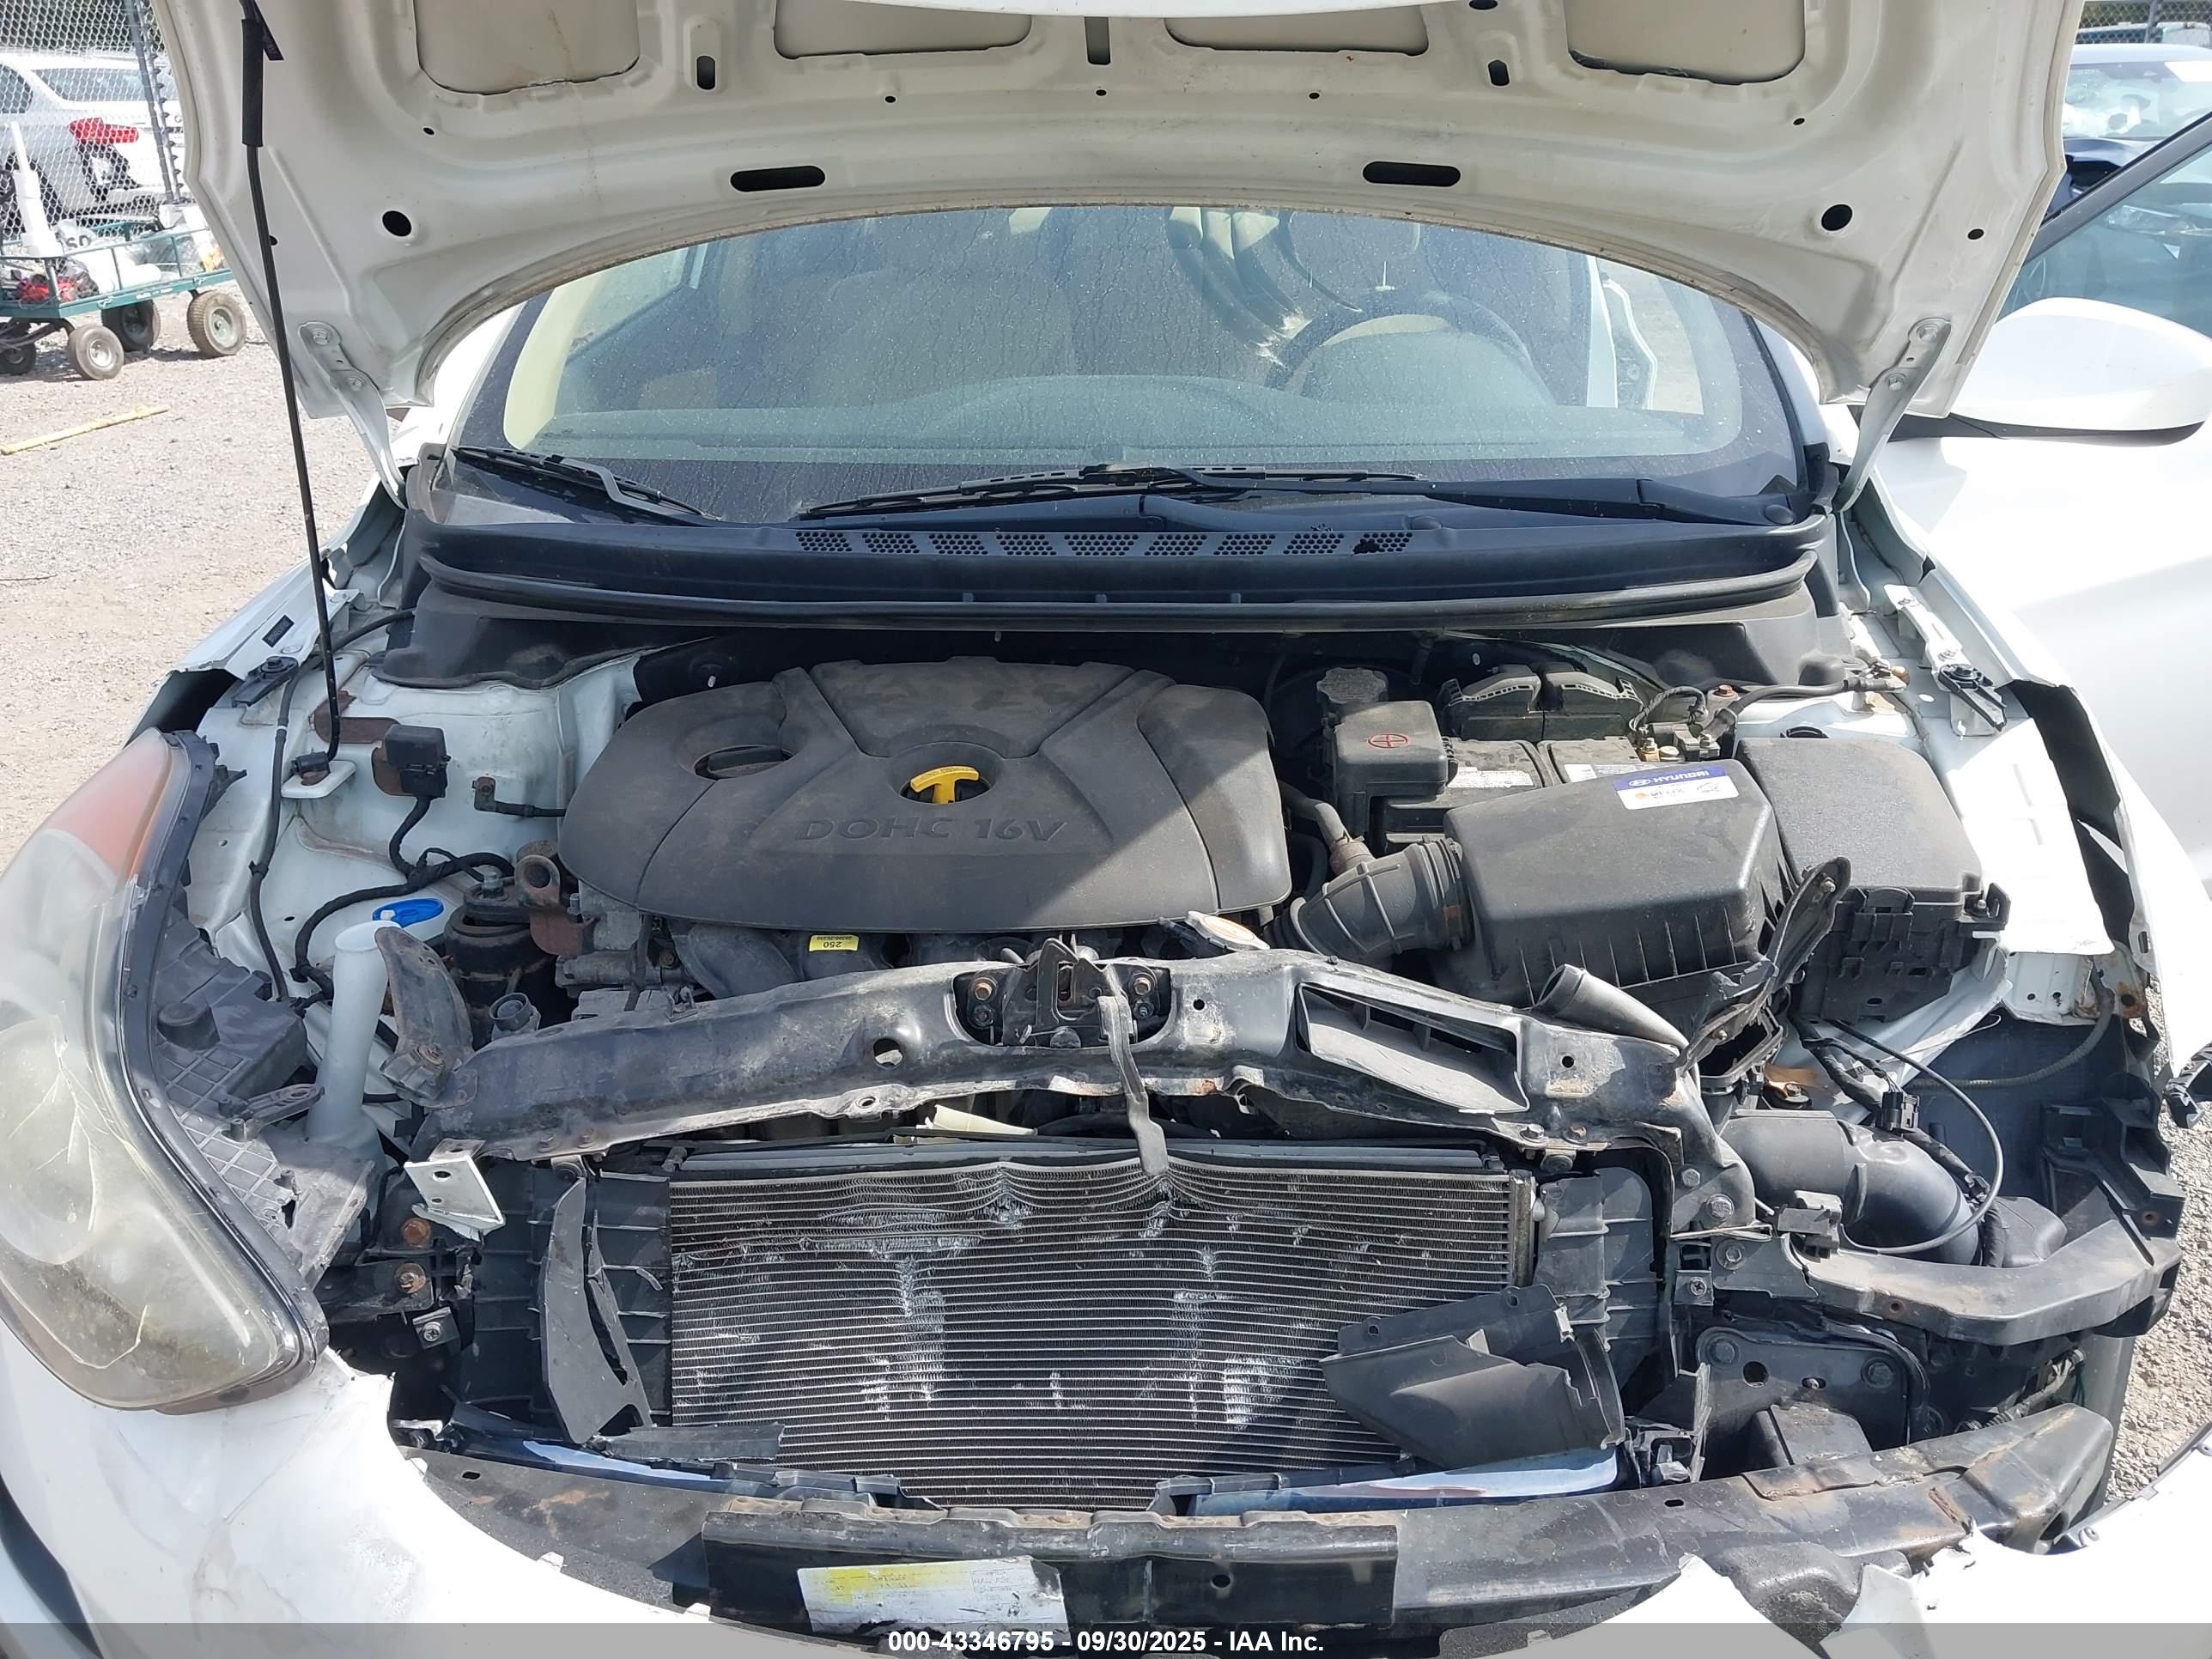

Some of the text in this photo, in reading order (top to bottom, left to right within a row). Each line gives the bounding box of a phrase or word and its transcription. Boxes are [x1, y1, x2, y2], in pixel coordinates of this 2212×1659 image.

[1653, 769, 1711, 783] HYUNDAI
[795, 817, 1067, 842] DOHC 16V
